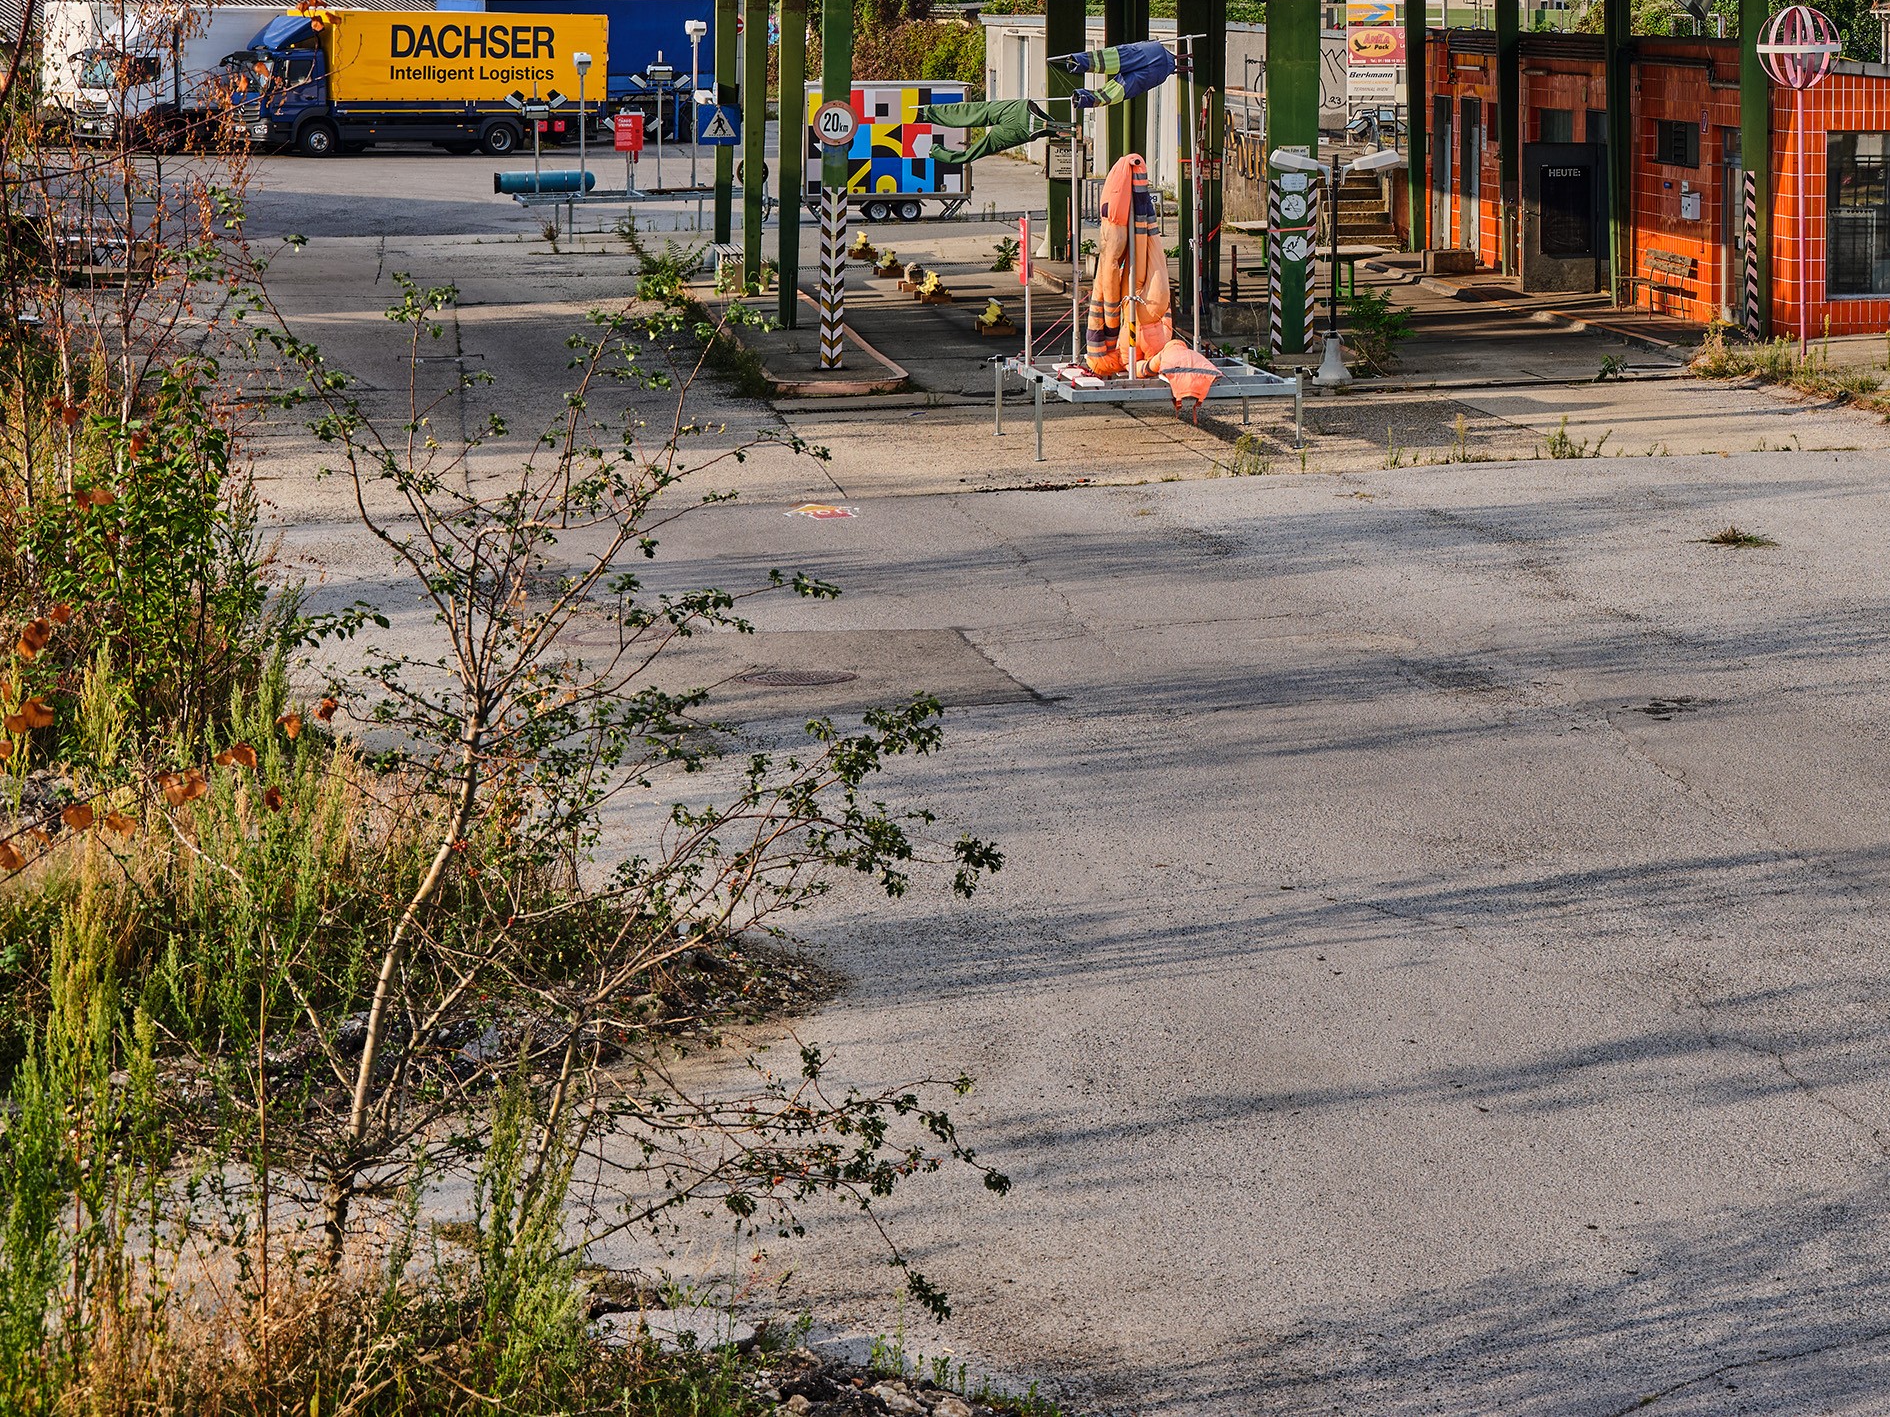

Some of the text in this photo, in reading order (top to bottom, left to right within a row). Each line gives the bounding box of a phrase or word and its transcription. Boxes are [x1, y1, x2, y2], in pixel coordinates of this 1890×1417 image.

[391, 24, 555, 59] DACHSER
[390, 65, 554, 83] Intelligent Logistics
[1349, 71, 1394, 79] Berkmann
[823, 112, 849, 133] 20 km
[1548, 168, 1581, 177] HEUTE:
